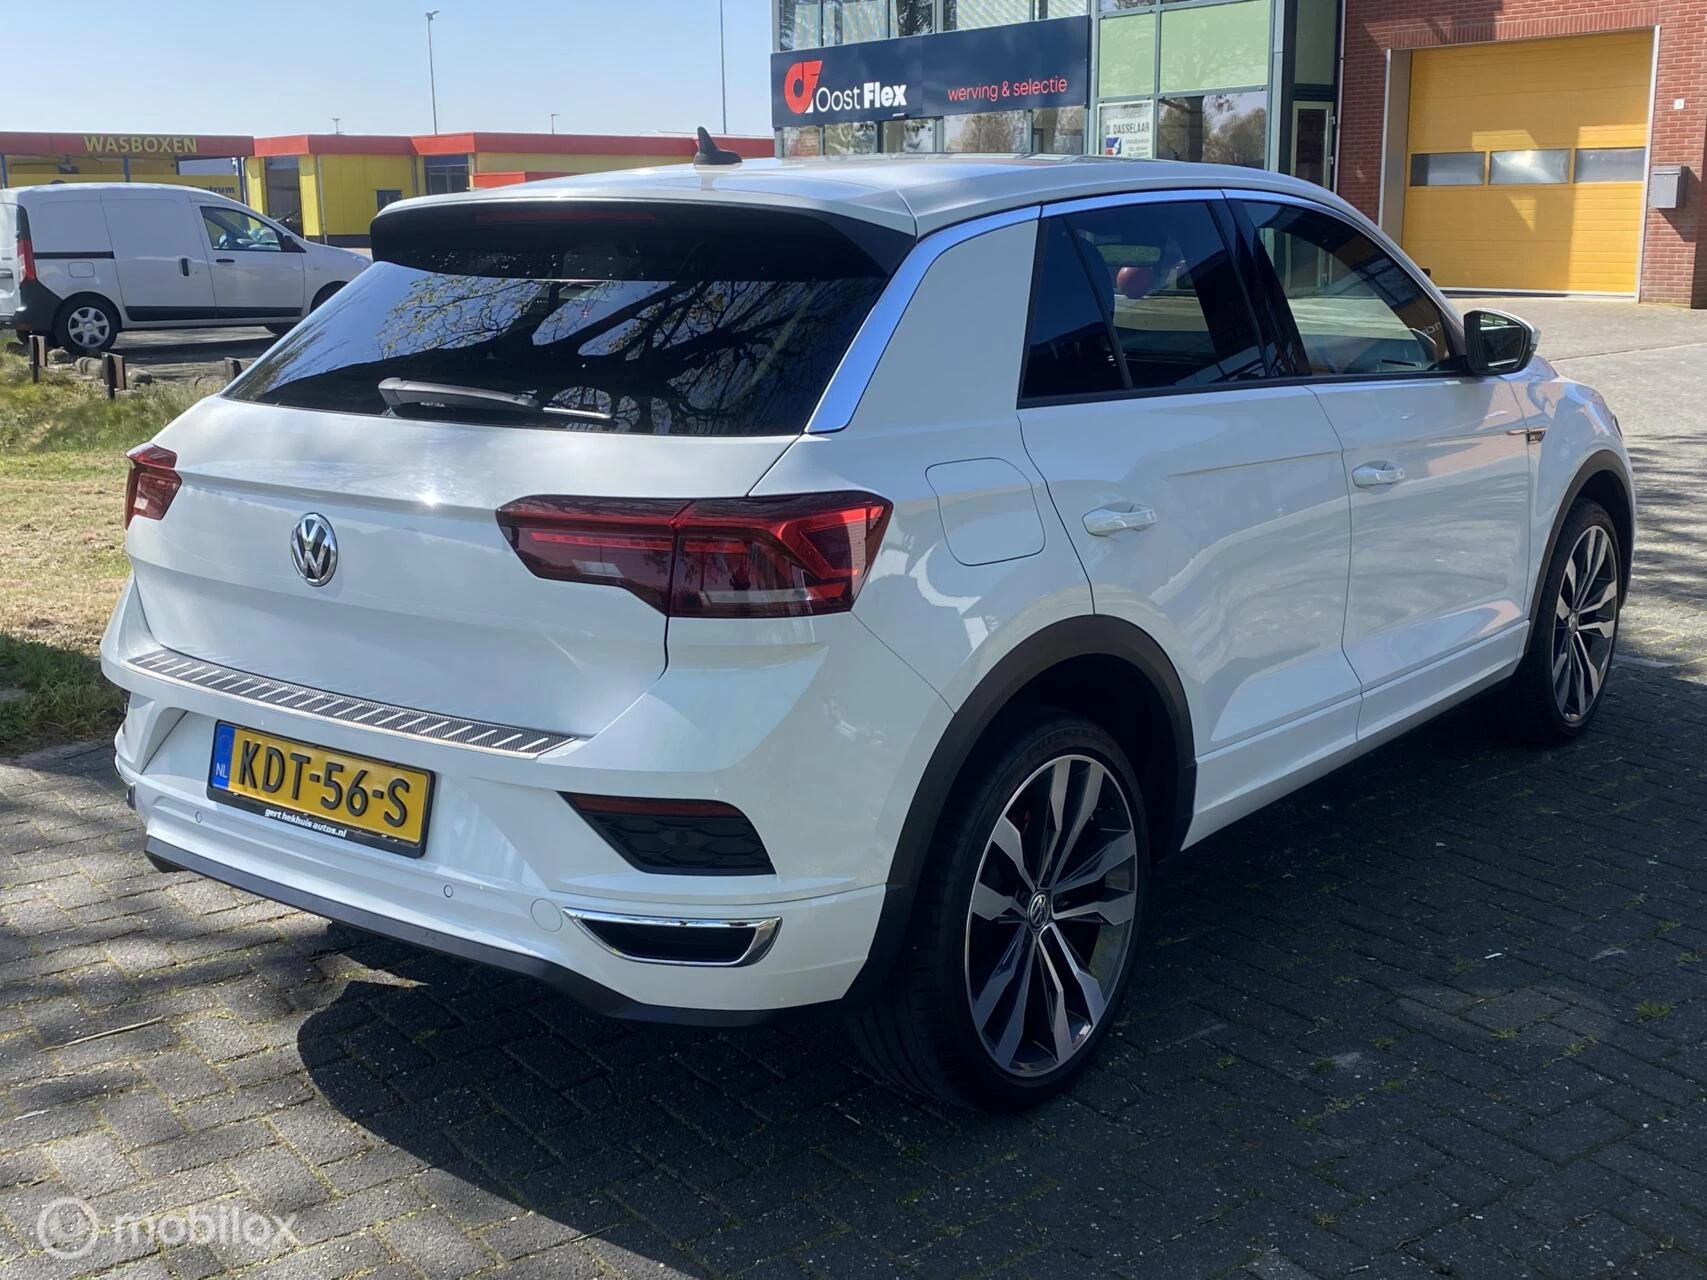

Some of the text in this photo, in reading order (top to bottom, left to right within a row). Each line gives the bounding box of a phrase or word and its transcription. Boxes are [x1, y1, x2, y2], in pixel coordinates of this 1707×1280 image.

[816, 81, 907, 112] Oost Flex
[947, 76, 1068, 102] werving & selectie
[1113, 121, 1150, 135] DASSELAAR
[83, 135, 198, 153] WASBOXEN
[215, 763, 228, 779] NL
[238, 739, 411, 828] KDT-56-S
[265, 808, 347, 838] gert hekhuis autos.nl
